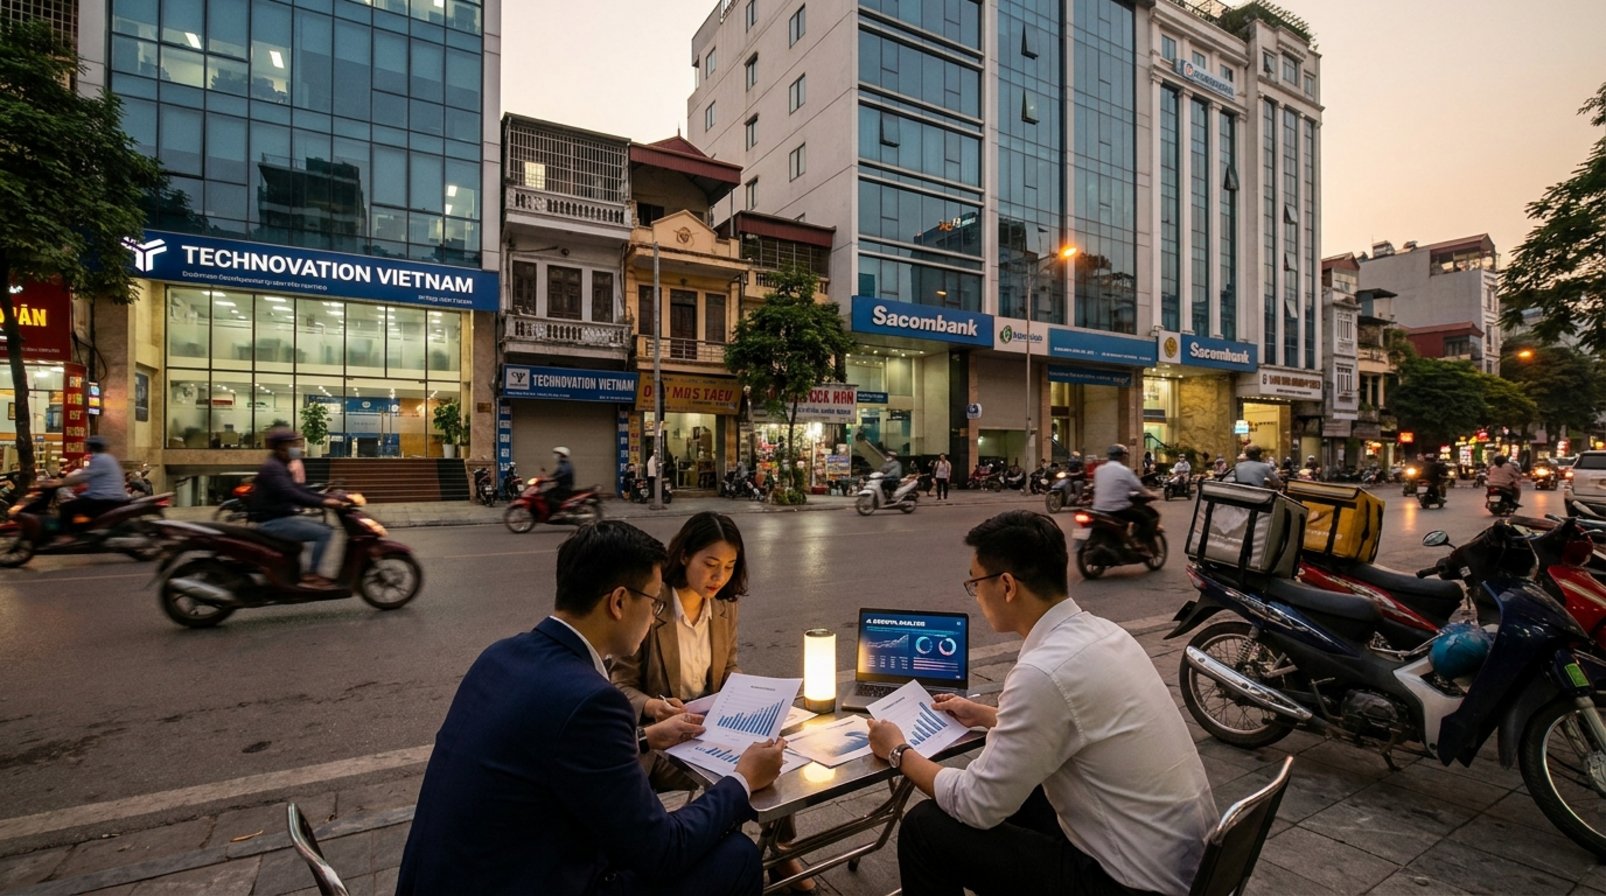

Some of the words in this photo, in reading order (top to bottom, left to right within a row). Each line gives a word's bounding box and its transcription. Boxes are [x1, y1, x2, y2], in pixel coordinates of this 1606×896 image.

[181, 244, 371, 283] TECHNOVATION
[376, 266, 474, 294] VIETNAM
[872, 305, 978, 337] Sacombank
[532, 373, 597, 390] TECHNOVATION
[598, 377, 635, 392] VIETNAM
